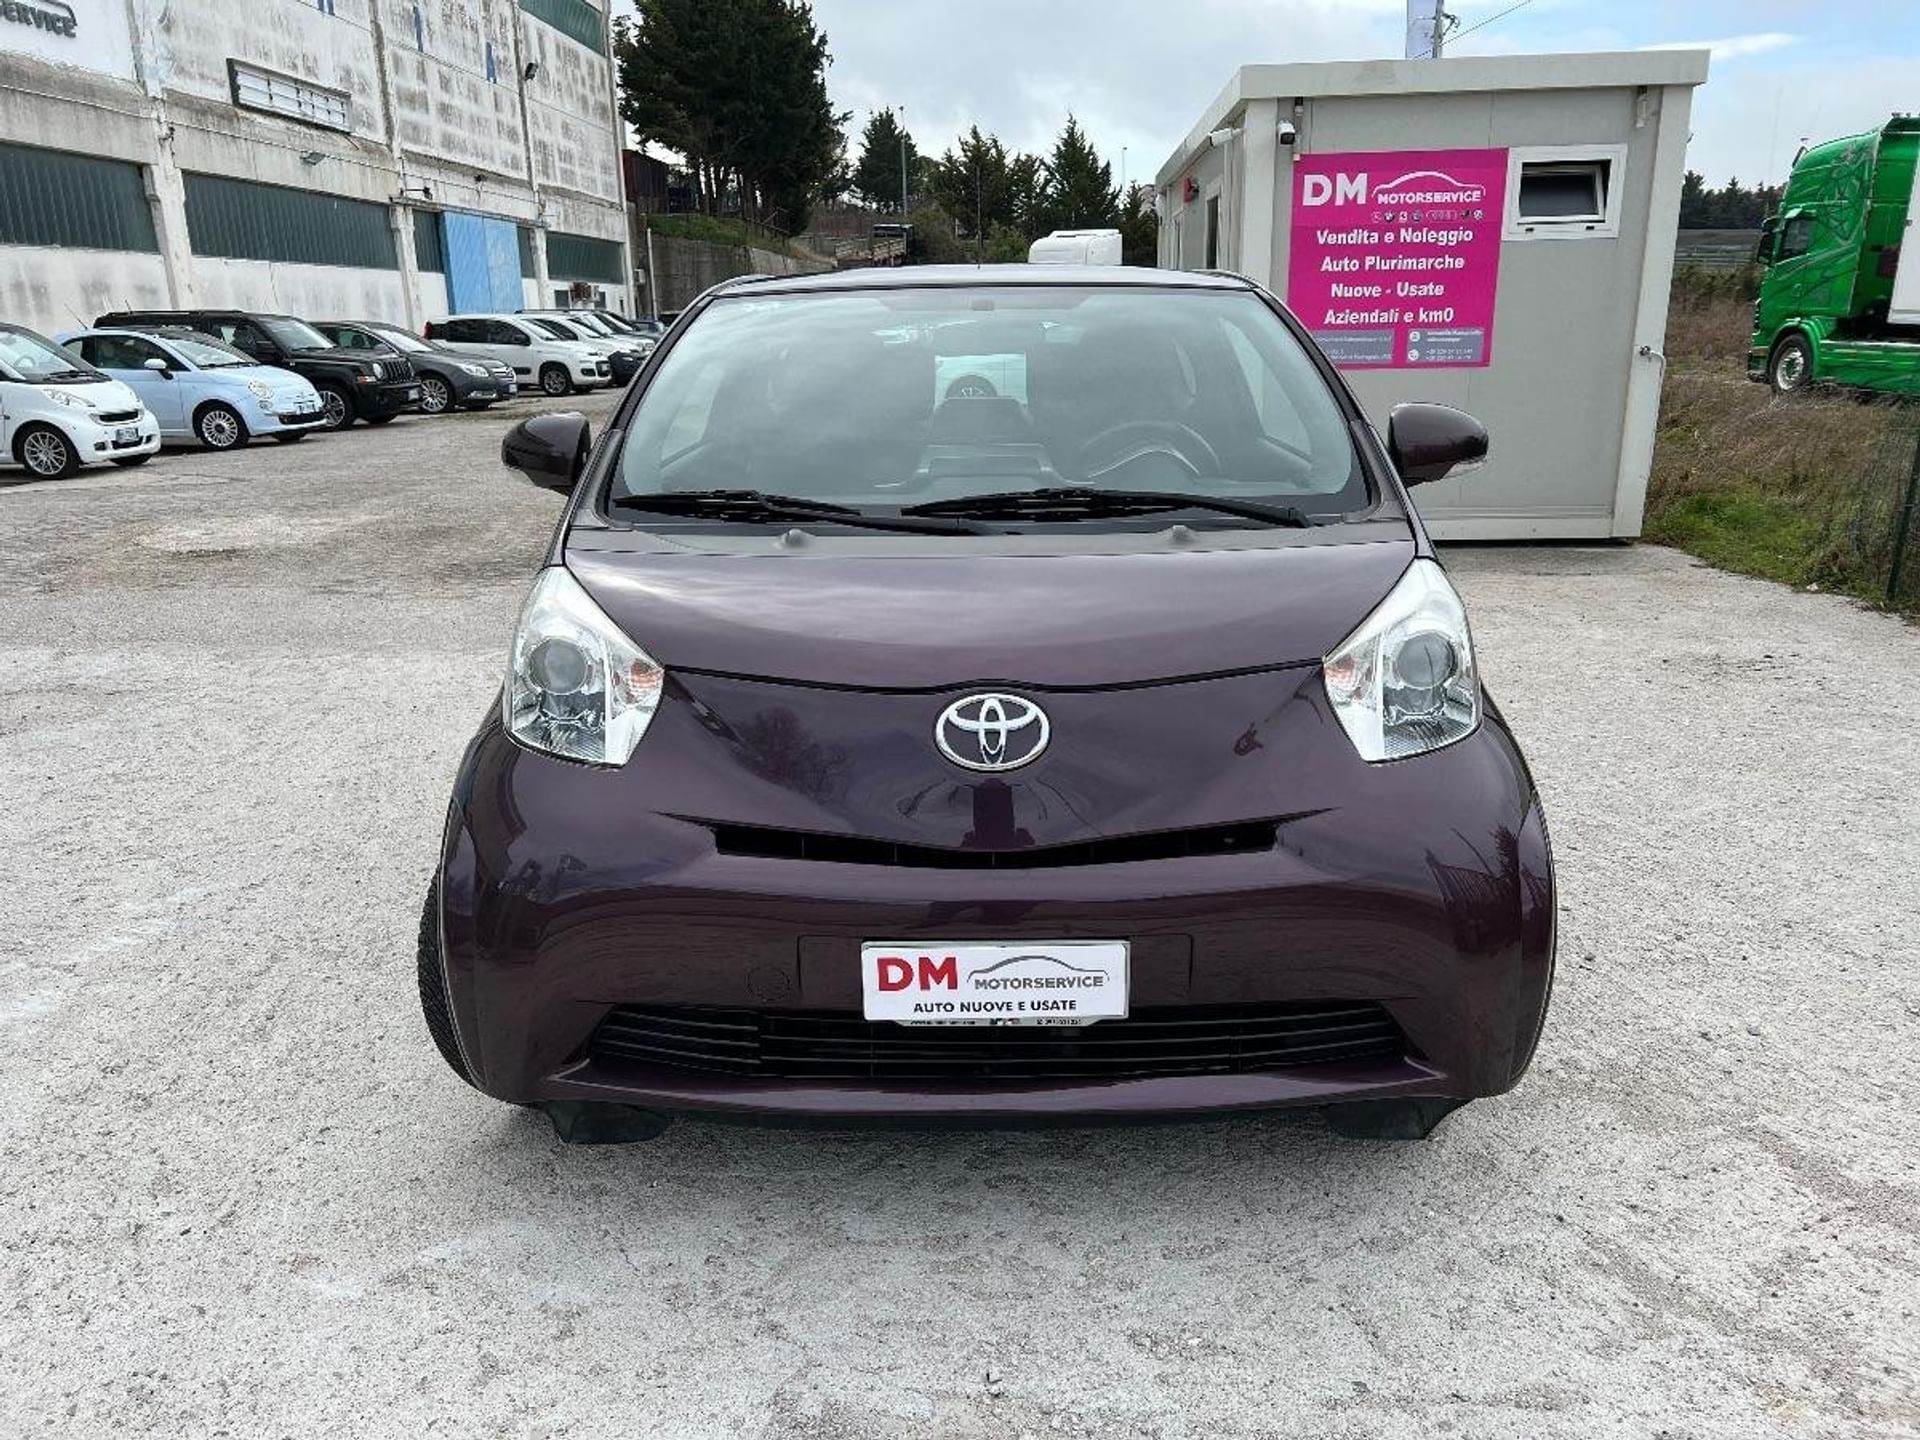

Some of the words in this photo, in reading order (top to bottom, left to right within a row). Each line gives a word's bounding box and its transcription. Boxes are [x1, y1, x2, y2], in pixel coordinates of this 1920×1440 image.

[1303, 173, 1368, 206] DM
[1377, 191, 1482, 204] MOTORSERVICE
[1317, 229, 1379, 245] Vendita
[1384, 233, 1395, 243] e
[1400, 227, 1473, 246] Noleggio
[1320, 256, 1360, 272] Auto
[1365, 255, 1465, 271] Plurimarche
[1331, 283, 1382, 298] Nuove
[1397, 281, 1445, 297] Usate
[1324, 308, 1400, 325] Aziendali
[1404, 313, 1414, 322] e
[1419, 307, 1454, 323] km0
[877, 956, 958, 992] DM
[974, 976, 1104, 991] MOTORSERVICE
[913, 1002, 955, 1013] AUTO
[960, 1001, 1014, 1013] NUOVE
[1018, 1001, 1026, 1011] E
[1030, 1000, 1077, 1012] USATE
